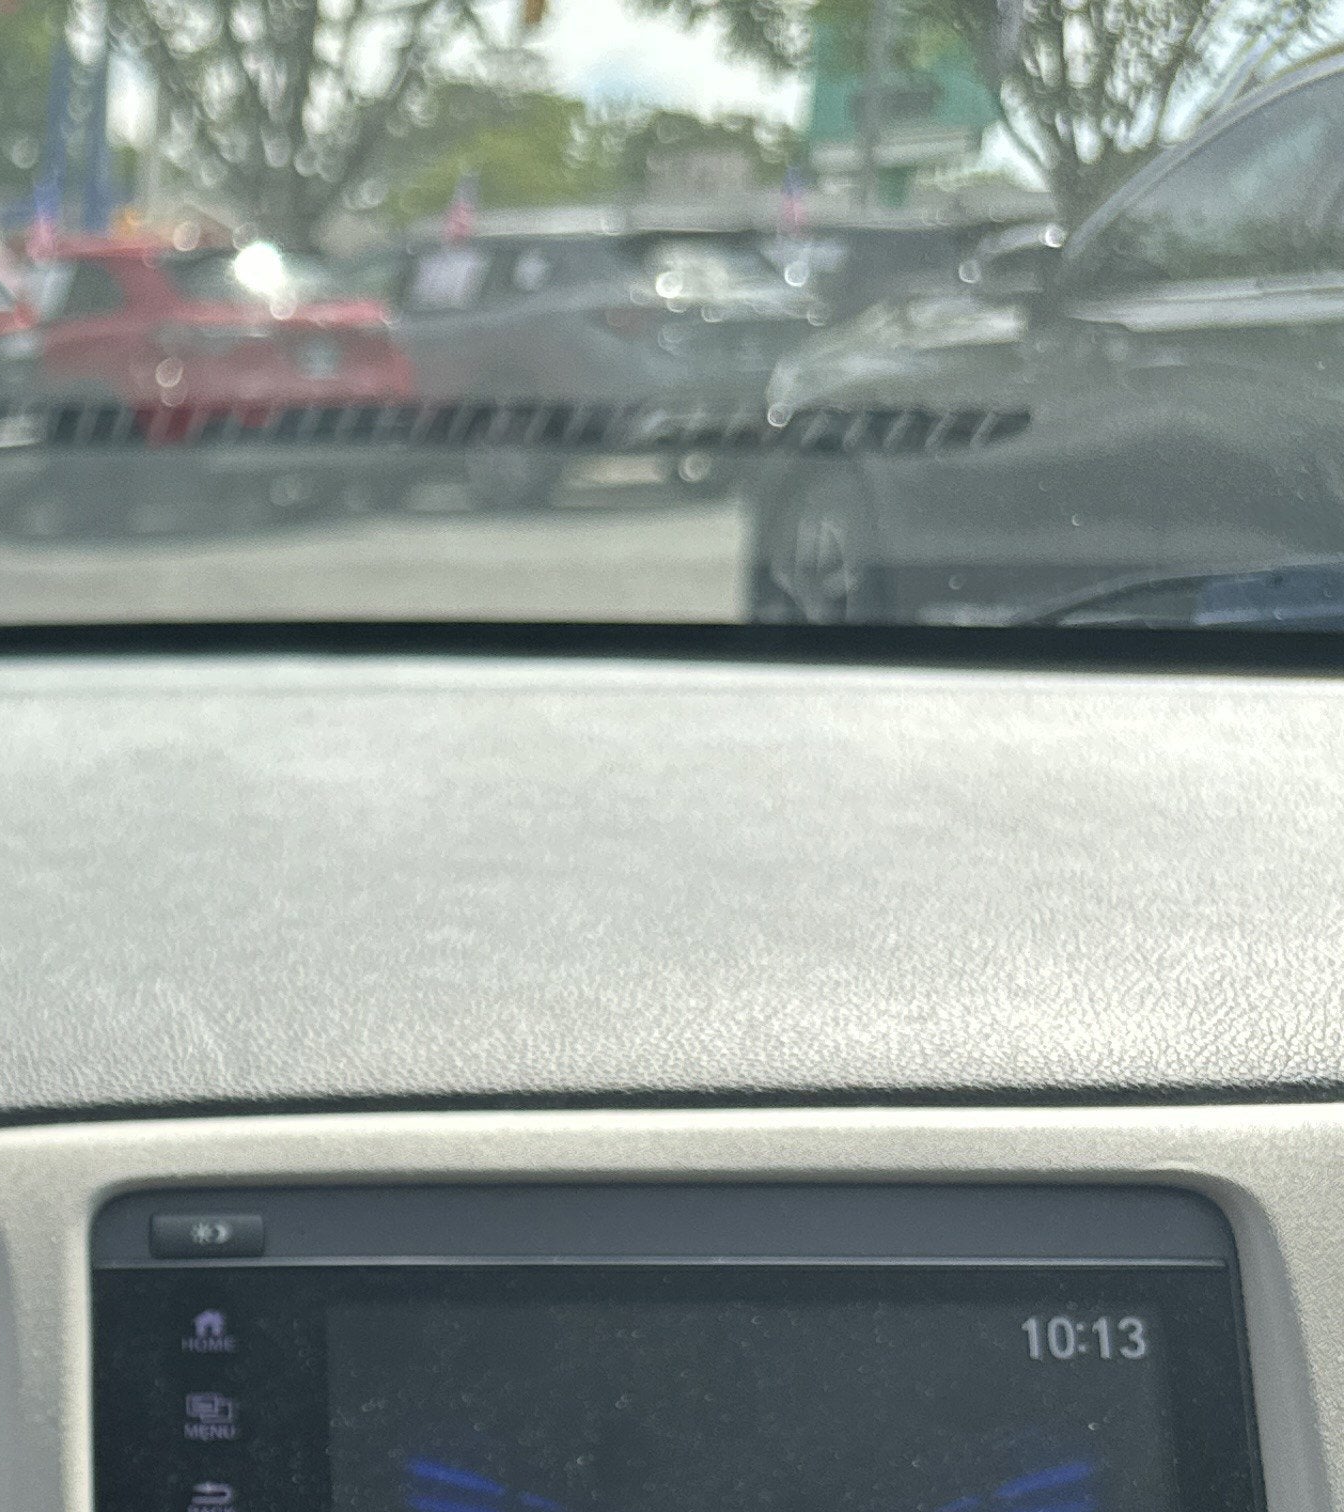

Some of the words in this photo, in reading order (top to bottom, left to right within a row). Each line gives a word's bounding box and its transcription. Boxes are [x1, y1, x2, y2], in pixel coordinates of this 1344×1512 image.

[181, 1337, 235, 1352] HOME
[1021, 1314, 1149, 1361] 10:13
[184, 1423, 236, 1440] MENU
